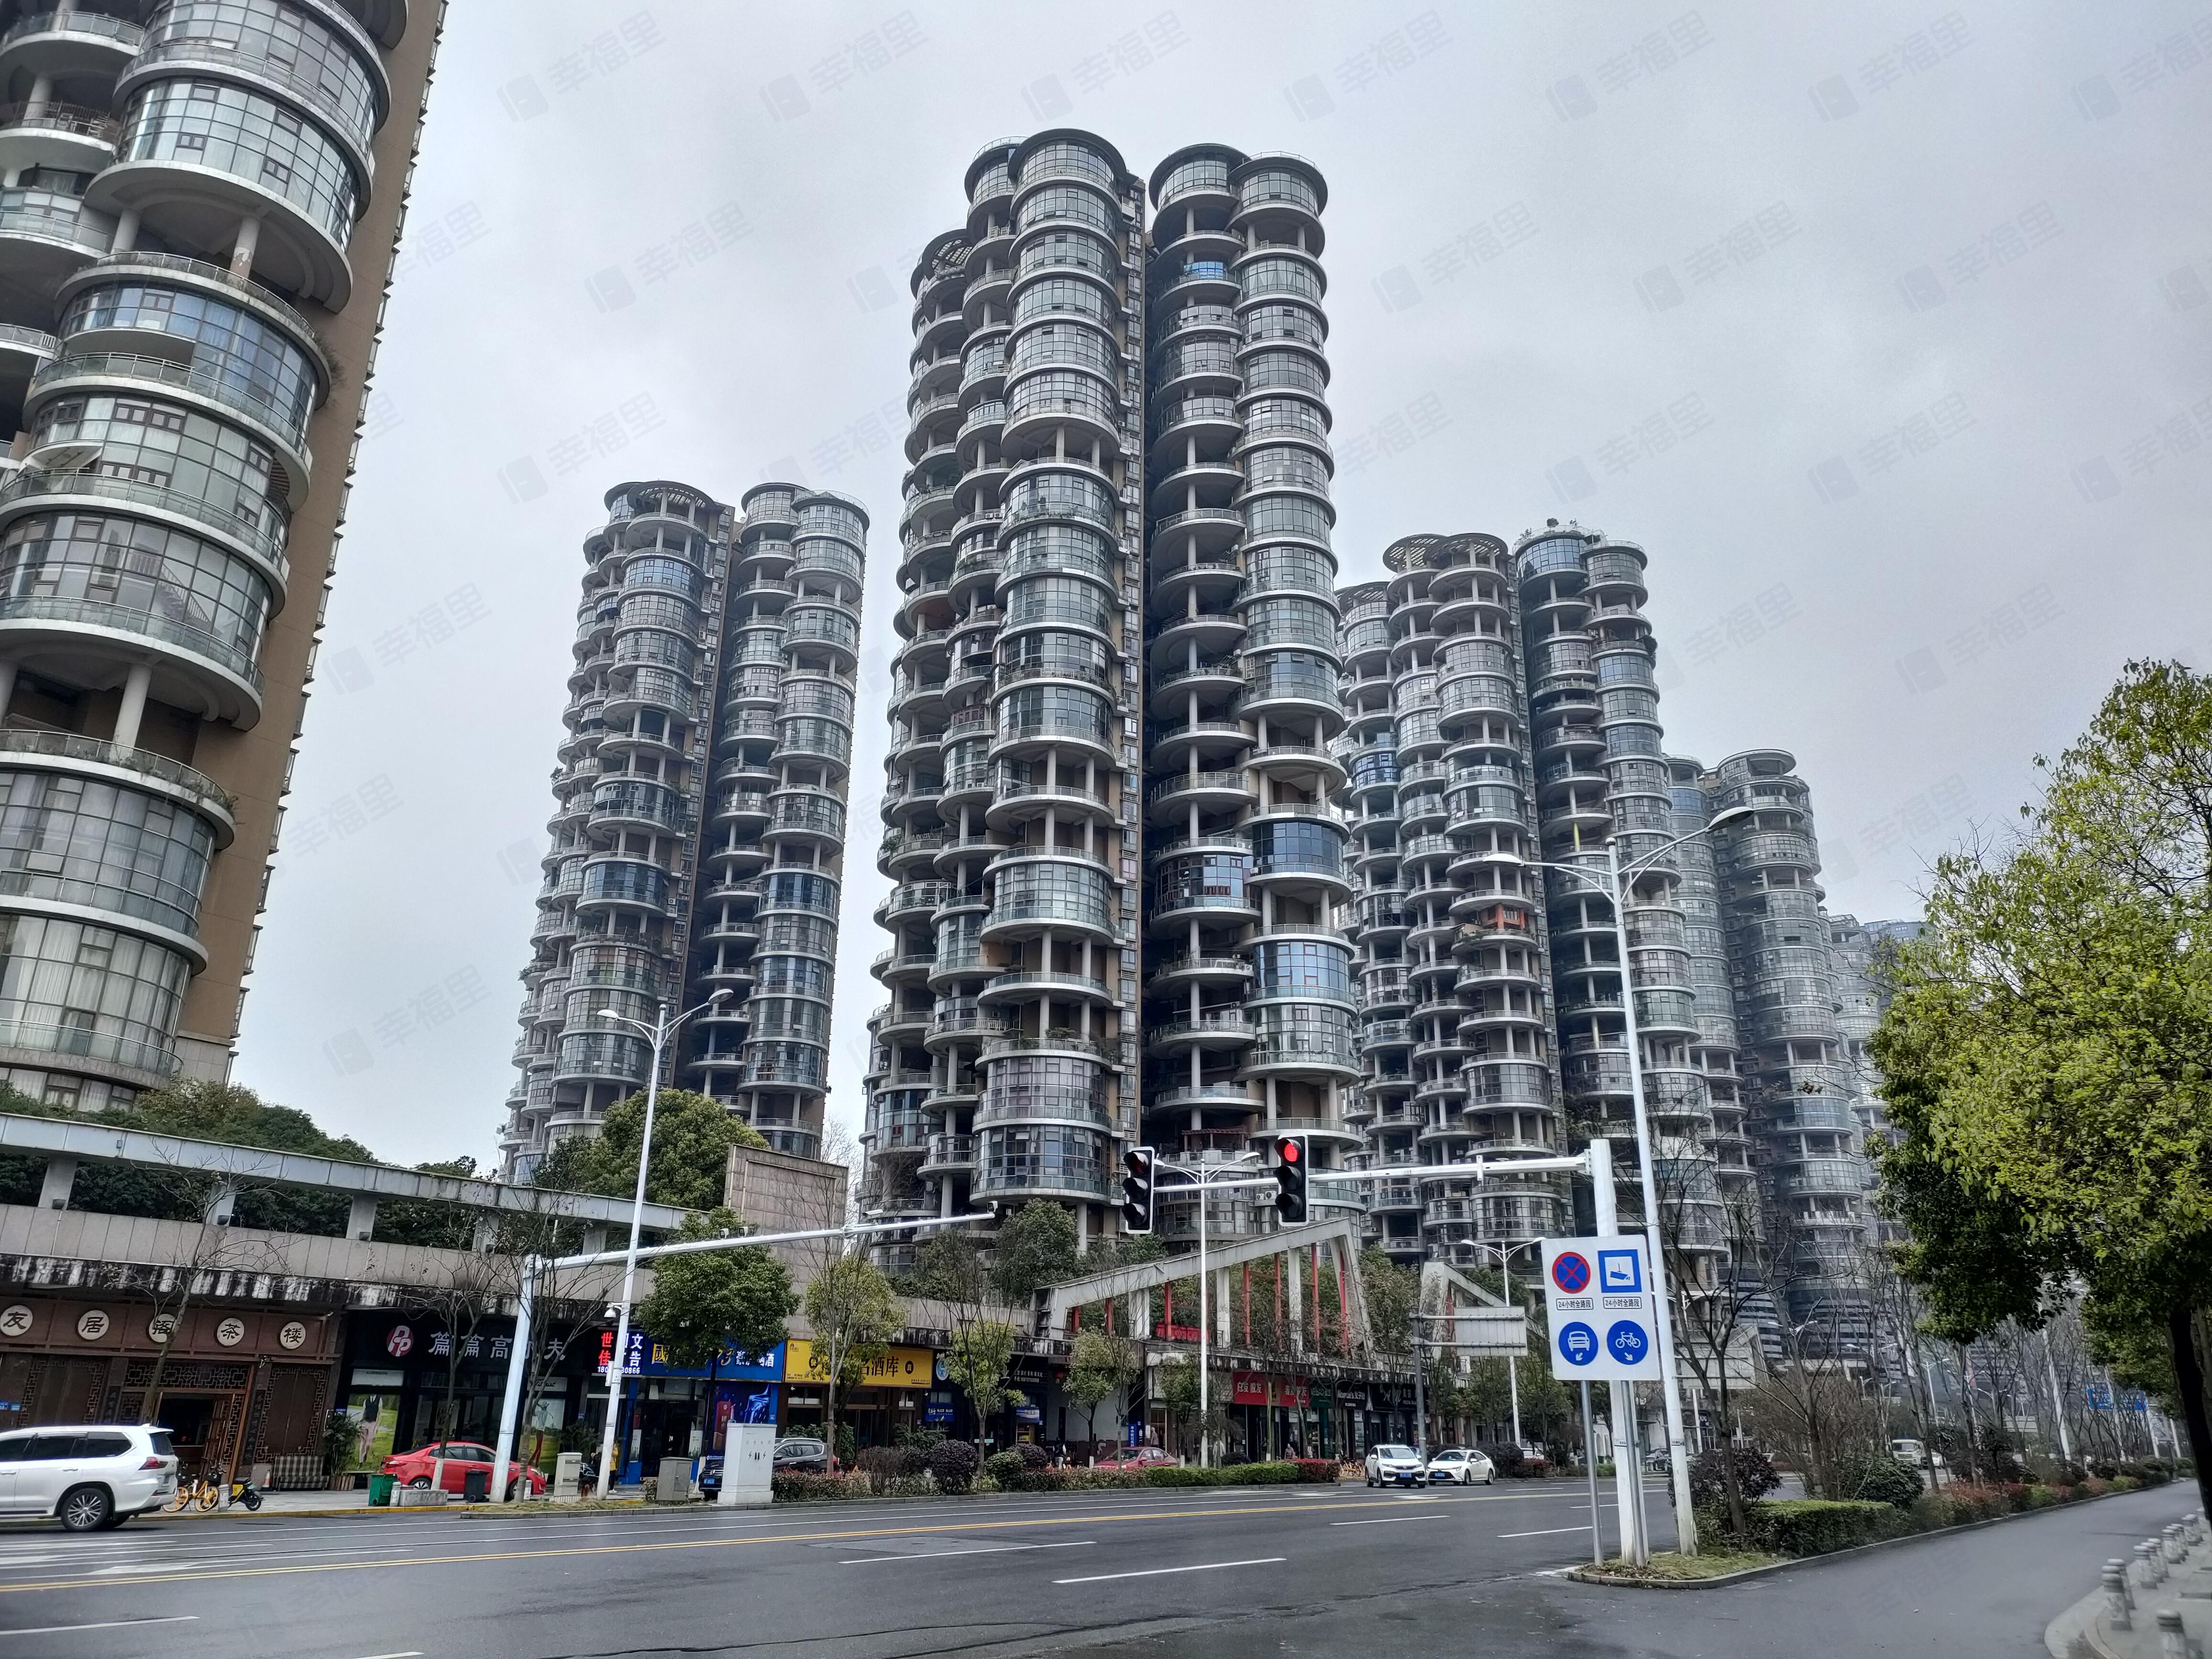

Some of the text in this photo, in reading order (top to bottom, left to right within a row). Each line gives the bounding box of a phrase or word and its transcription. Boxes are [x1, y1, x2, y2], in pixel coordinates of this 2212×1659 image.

[1559, 1300, 1591, 1308] 24小时全路段
[1605, 1299, 1639, 1307] 24小时全路段
